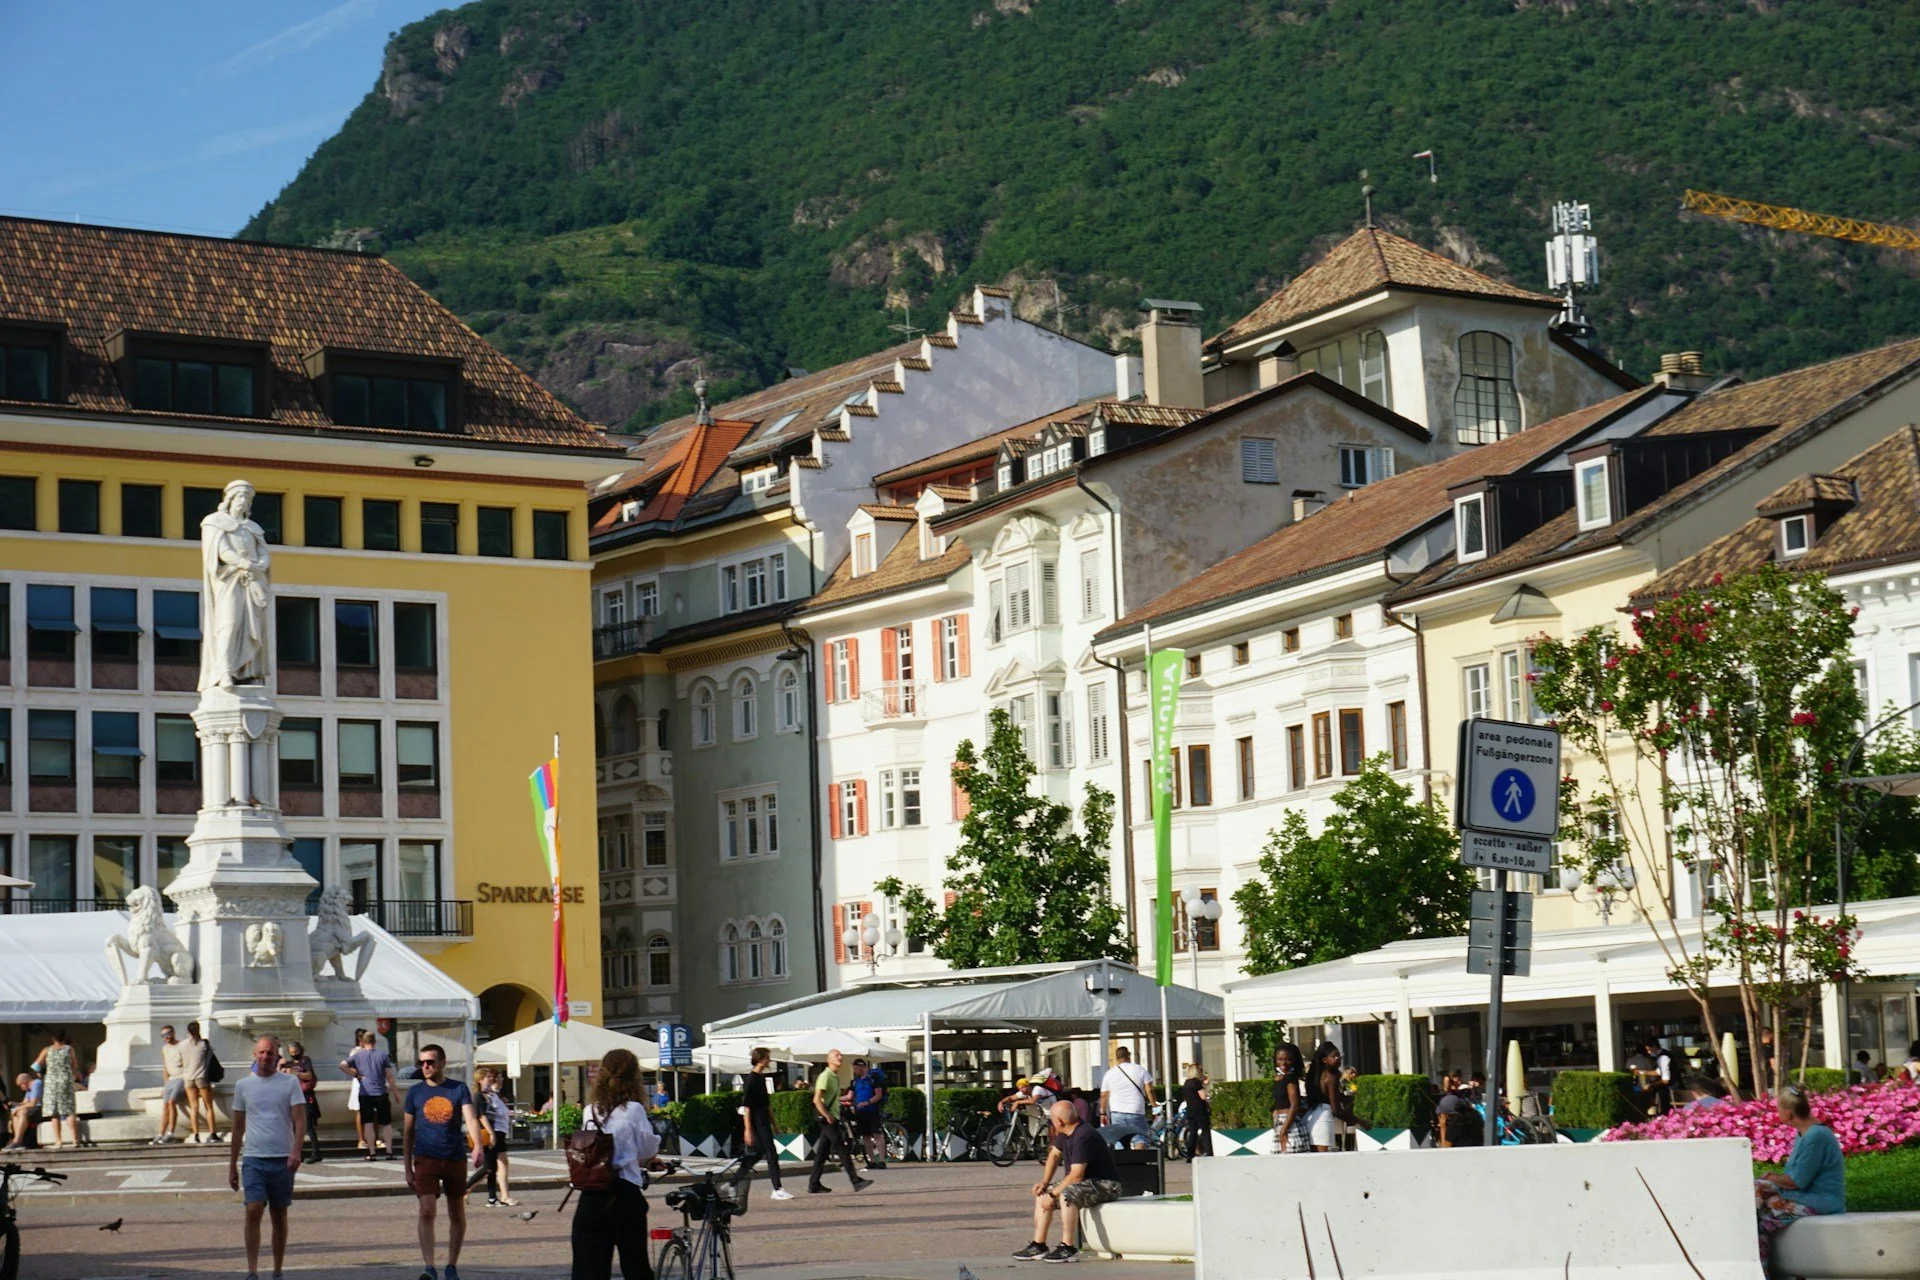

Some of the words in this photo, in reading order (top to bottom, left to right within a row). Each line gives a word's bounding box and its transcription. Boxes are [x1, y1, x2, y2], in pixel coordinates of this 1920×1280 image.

[1478, 731, 1501, 742] area
[1505, 735, 1553, 749] pedonale
[1475, 745, 1554, 765] Fußgängerzone
[1473, 837, 1506, 849] eccetto
[1516, 842, 1543, 853] außer
[477, 882, 585, 904] SPARKASE
[659, 1032, 669, 1048] P
[674, 1031, 687, 1048] P
